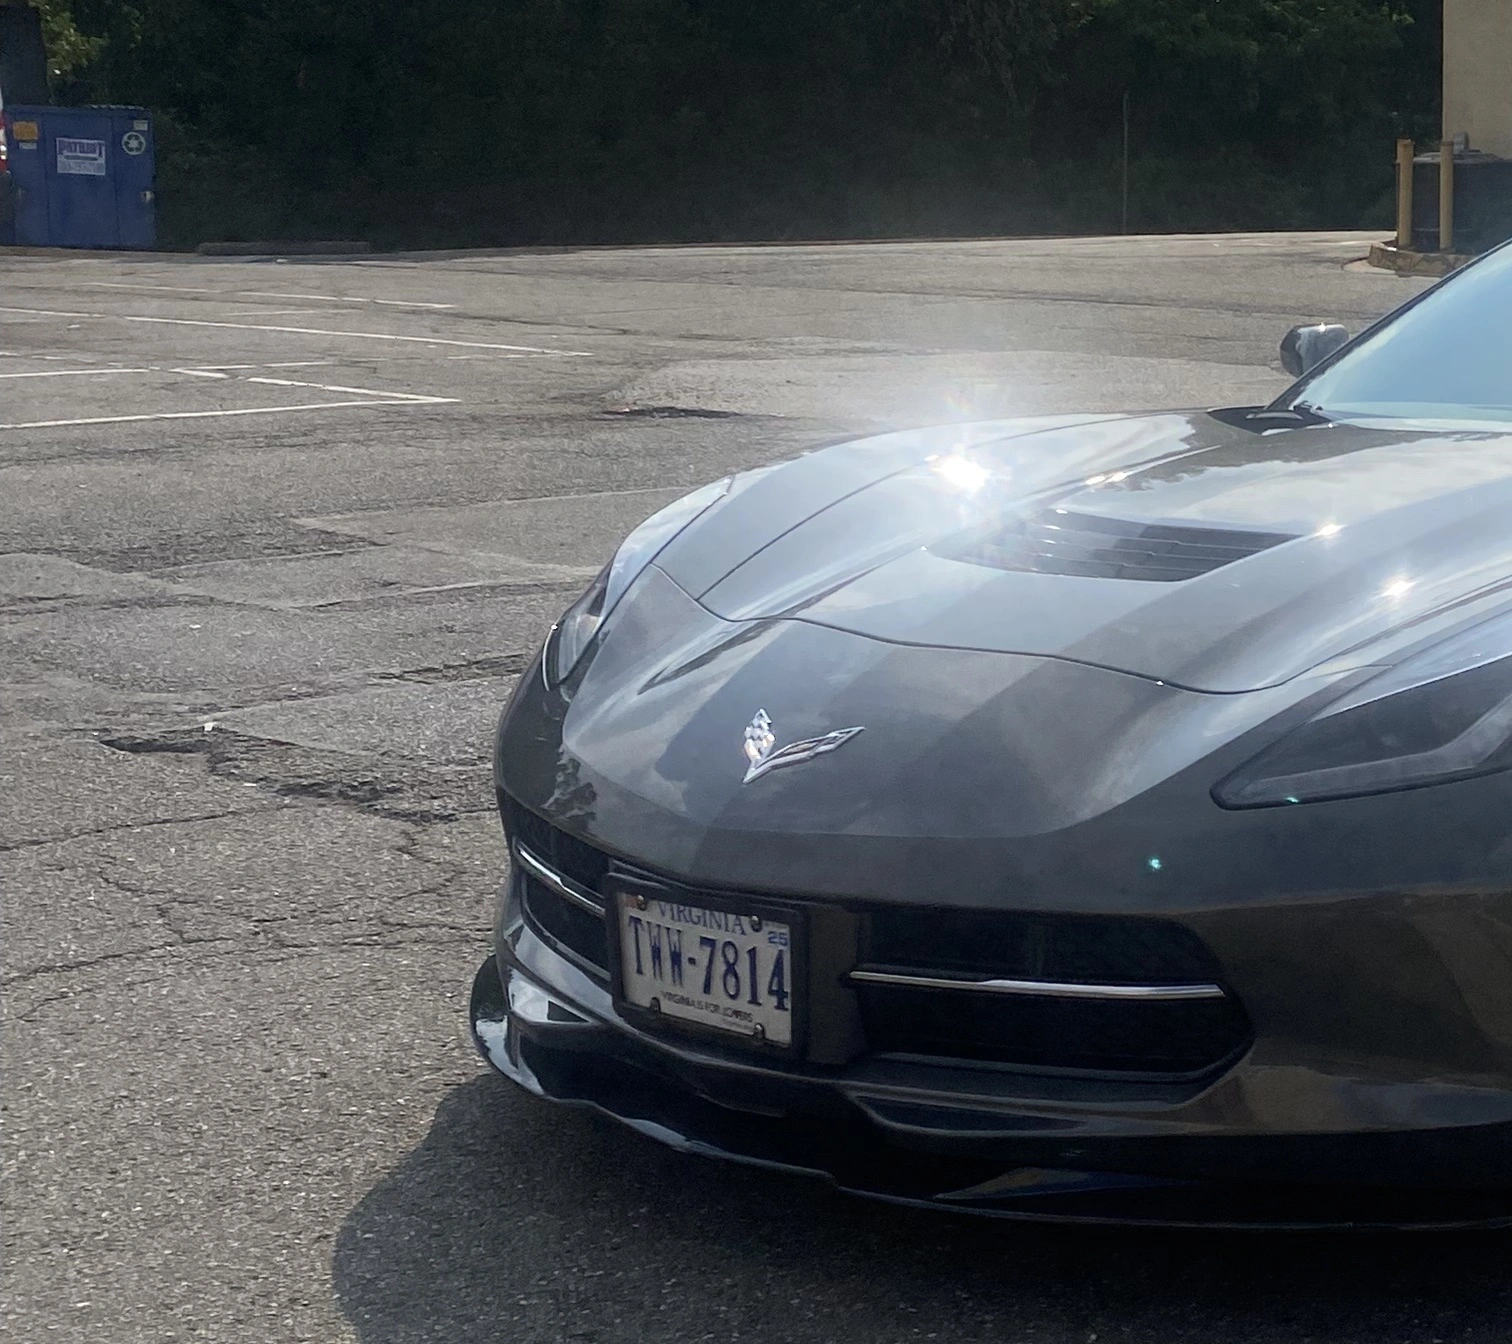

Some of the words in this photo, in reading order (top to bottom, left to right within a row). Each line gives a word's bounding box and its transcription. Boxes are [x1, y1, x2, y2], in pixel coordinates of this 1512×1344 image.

[656, 900, 747, 936] VIRGINIA
[768, 930, 789, 947] 25
[628, 915, 789, 1012] TWW-7814
